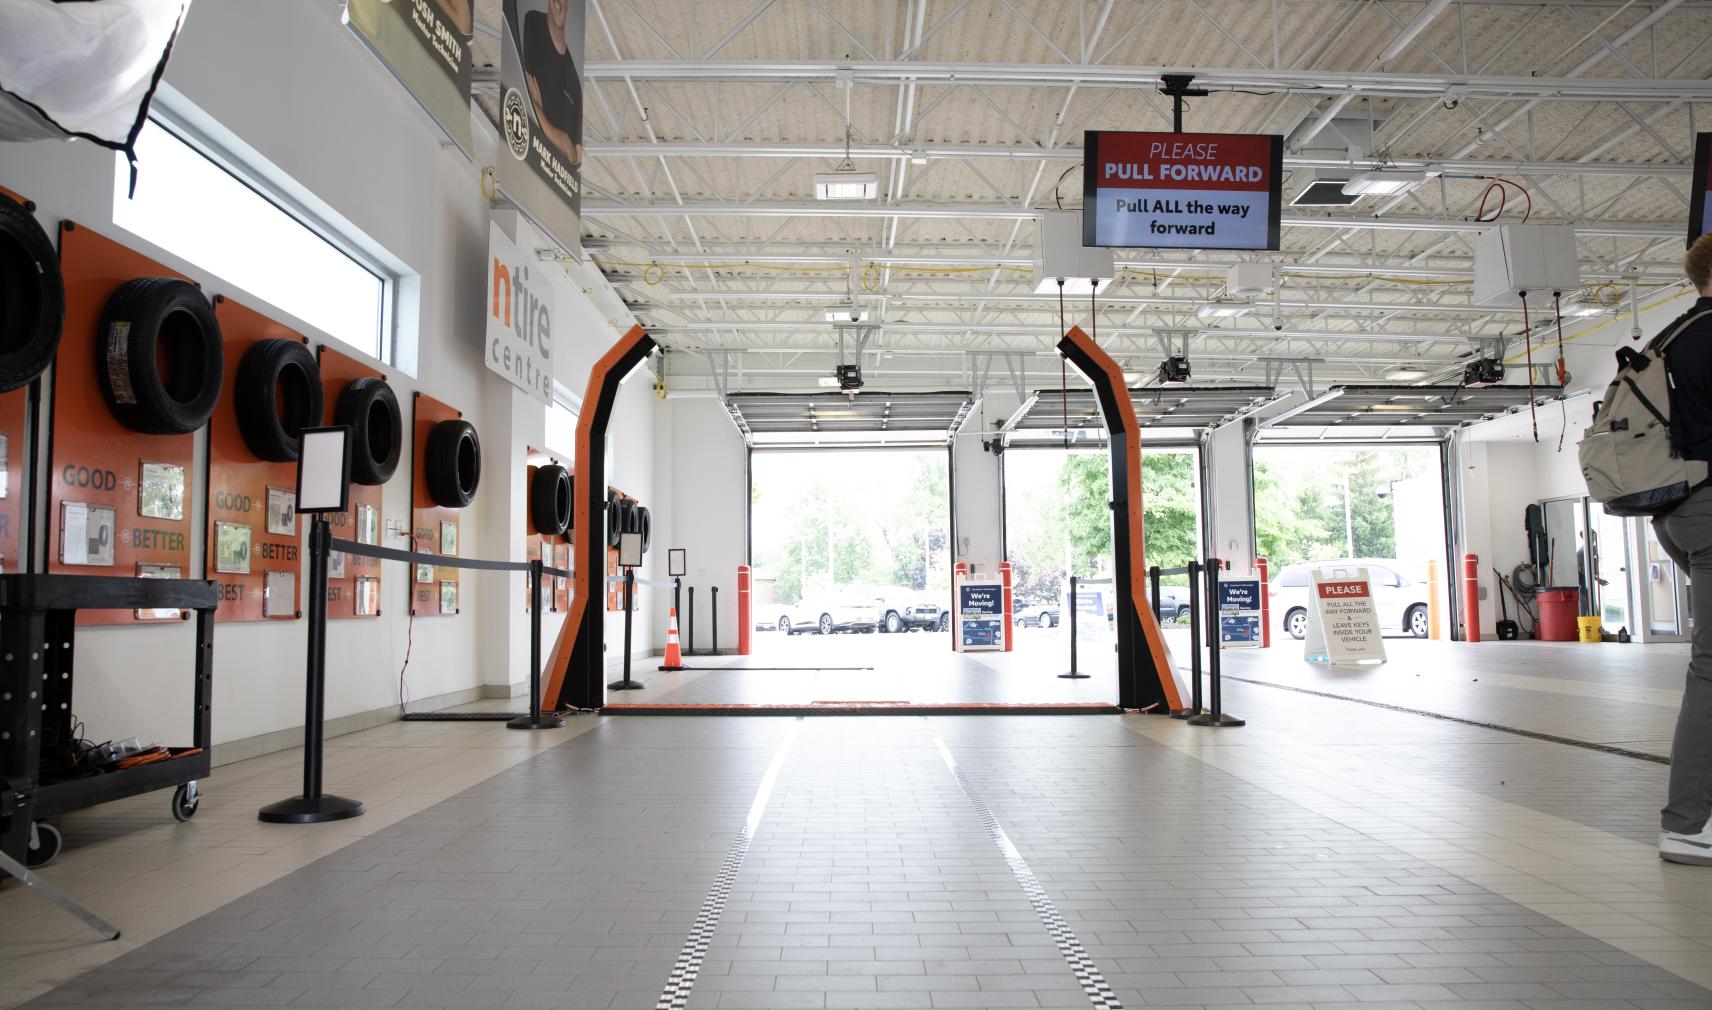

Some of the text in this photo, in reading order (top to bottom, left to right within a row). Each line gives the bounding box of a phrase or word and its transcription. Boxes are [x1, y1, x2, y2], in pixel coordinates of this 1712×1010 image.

[412, 0, 461, 62] OSH SMITH
[412, 8, 459, 73] Master Technician
[1150, 142, 1218, 160] PLEASE
[532, 136, 579, 193] MARK HADFIELD
[1105, 163, 1263, 183] PULL FORWARD
[540, 159, 573, 199] Master Technician
[1116, 199, 1250, 218] Pull ALL the way
[1150, 220, 1215, 235] forward
[492, 337, 549, 397] centre
[63, 464, 116, 492] GOOD
[216, 491, 251, 512] GOOD
[132, 528, 185, 551] BETTER
[262, 542, 298, 561] BETTER
[217, 583, 245, 602] BEST
[327, 586, 342, 602] EST
[1226, 595, 1252, 603] Moving!
[1325, 585, 1362, 595] PLEASE
